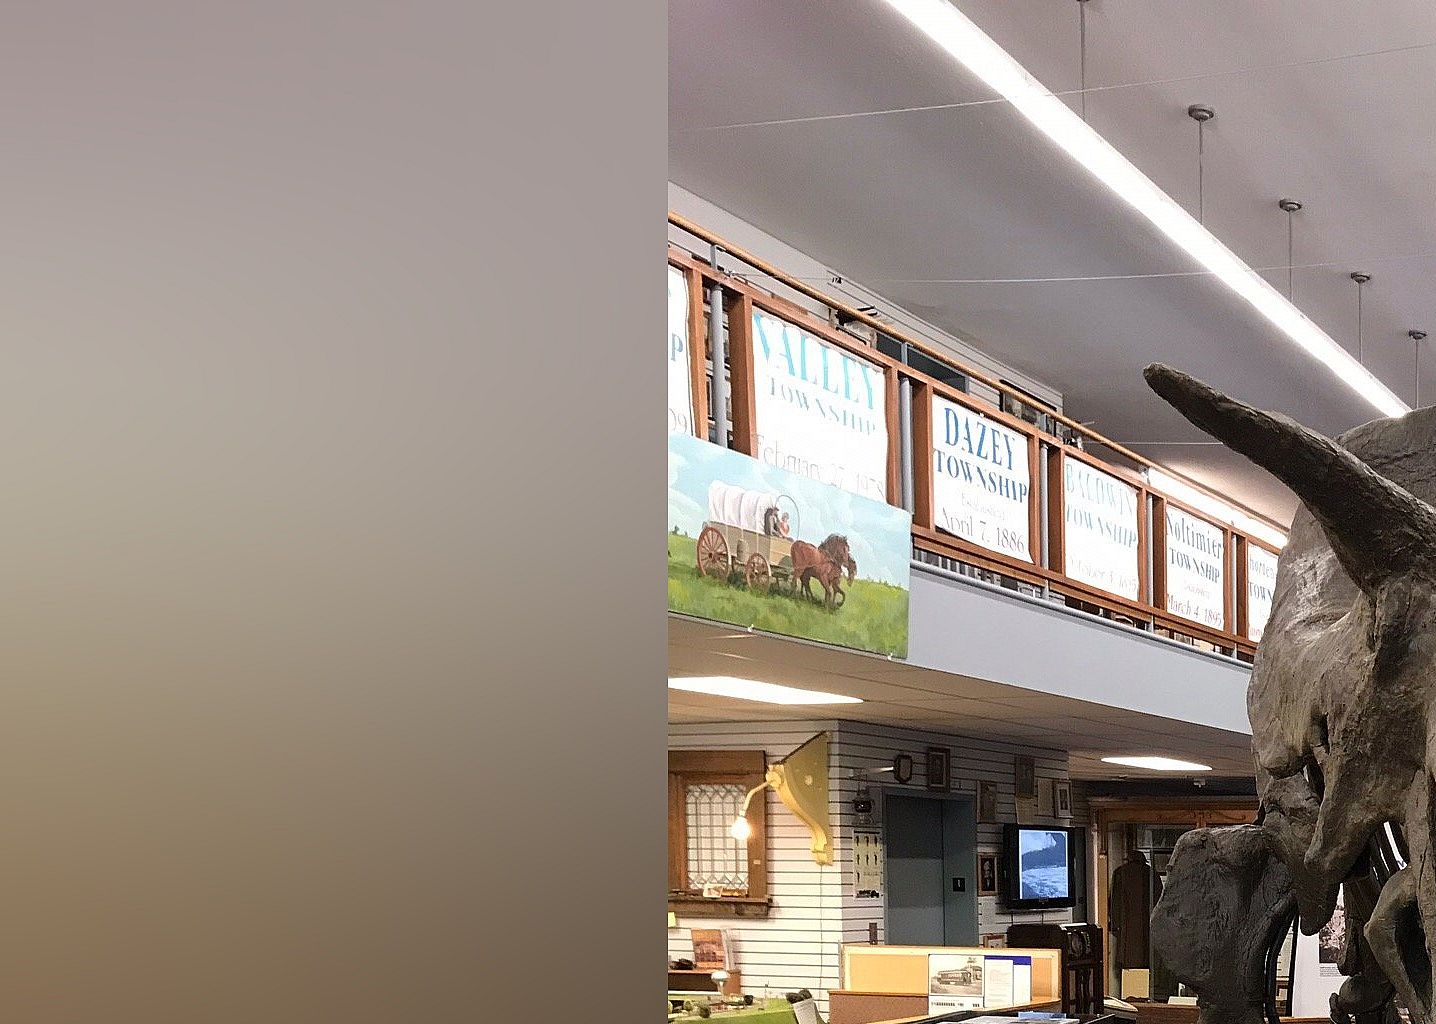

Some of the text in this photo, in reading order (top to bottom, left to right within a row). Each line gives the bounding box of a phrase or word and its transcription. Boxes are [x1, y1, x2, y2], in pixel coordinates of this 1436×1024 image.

[754, 312, 876, 410] VALLEY
[771, 377, 876, 435] TOWNSHIP
[944, 407, 1016, 470] DAZEY
[933, 448, 1027, 503] TOWNSHIP
[1066, 464, 1135, 517] BALDWIN
[942, 507, 973, 537] April
[996, 527, 1025, 554] 1886
[1066, 504, 1136, 548] TOWNSHIP
[1169, 547, 1220, 584] TOWNSHIP
